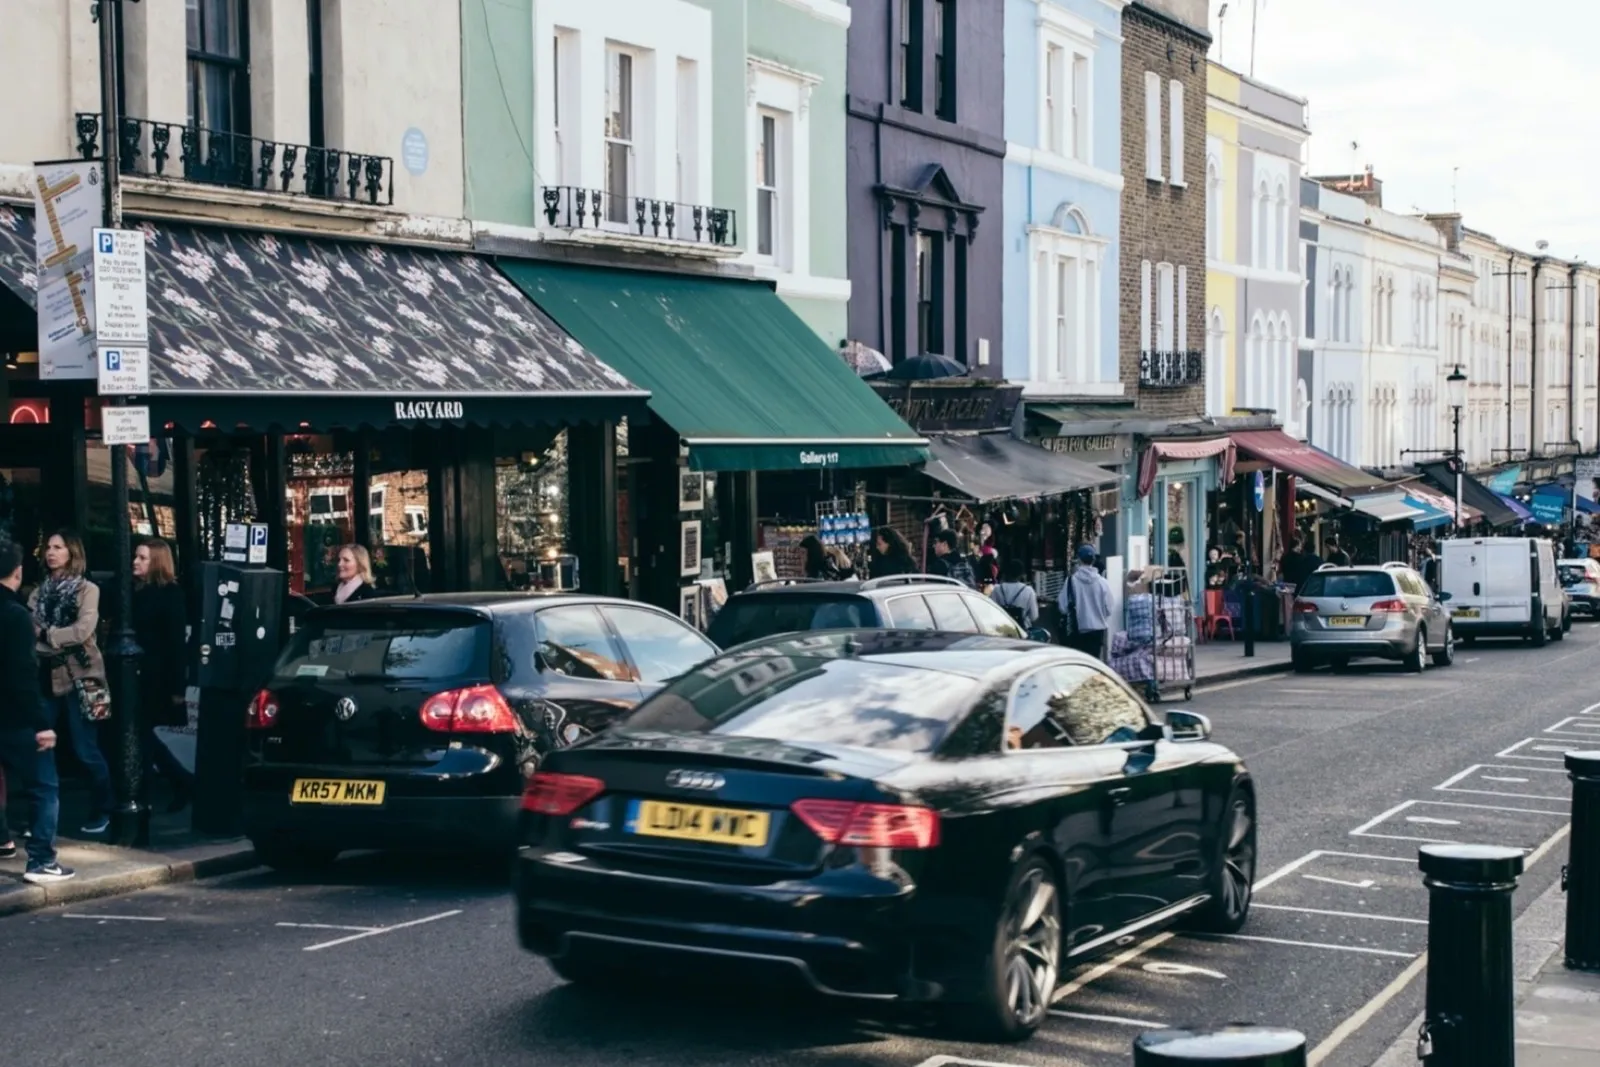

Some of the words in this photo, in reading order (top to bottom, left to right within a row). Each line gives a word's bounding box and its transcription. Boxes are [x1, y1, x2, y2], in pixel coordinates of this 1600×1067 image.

[394, 401, 464, 420] RAGYARD
[800, 450, 826, 467] Gallery
[827, 452, 839, 463] 117
[299, 781, 341, 799] KR57
[343, 783, 378, 801] MKM
